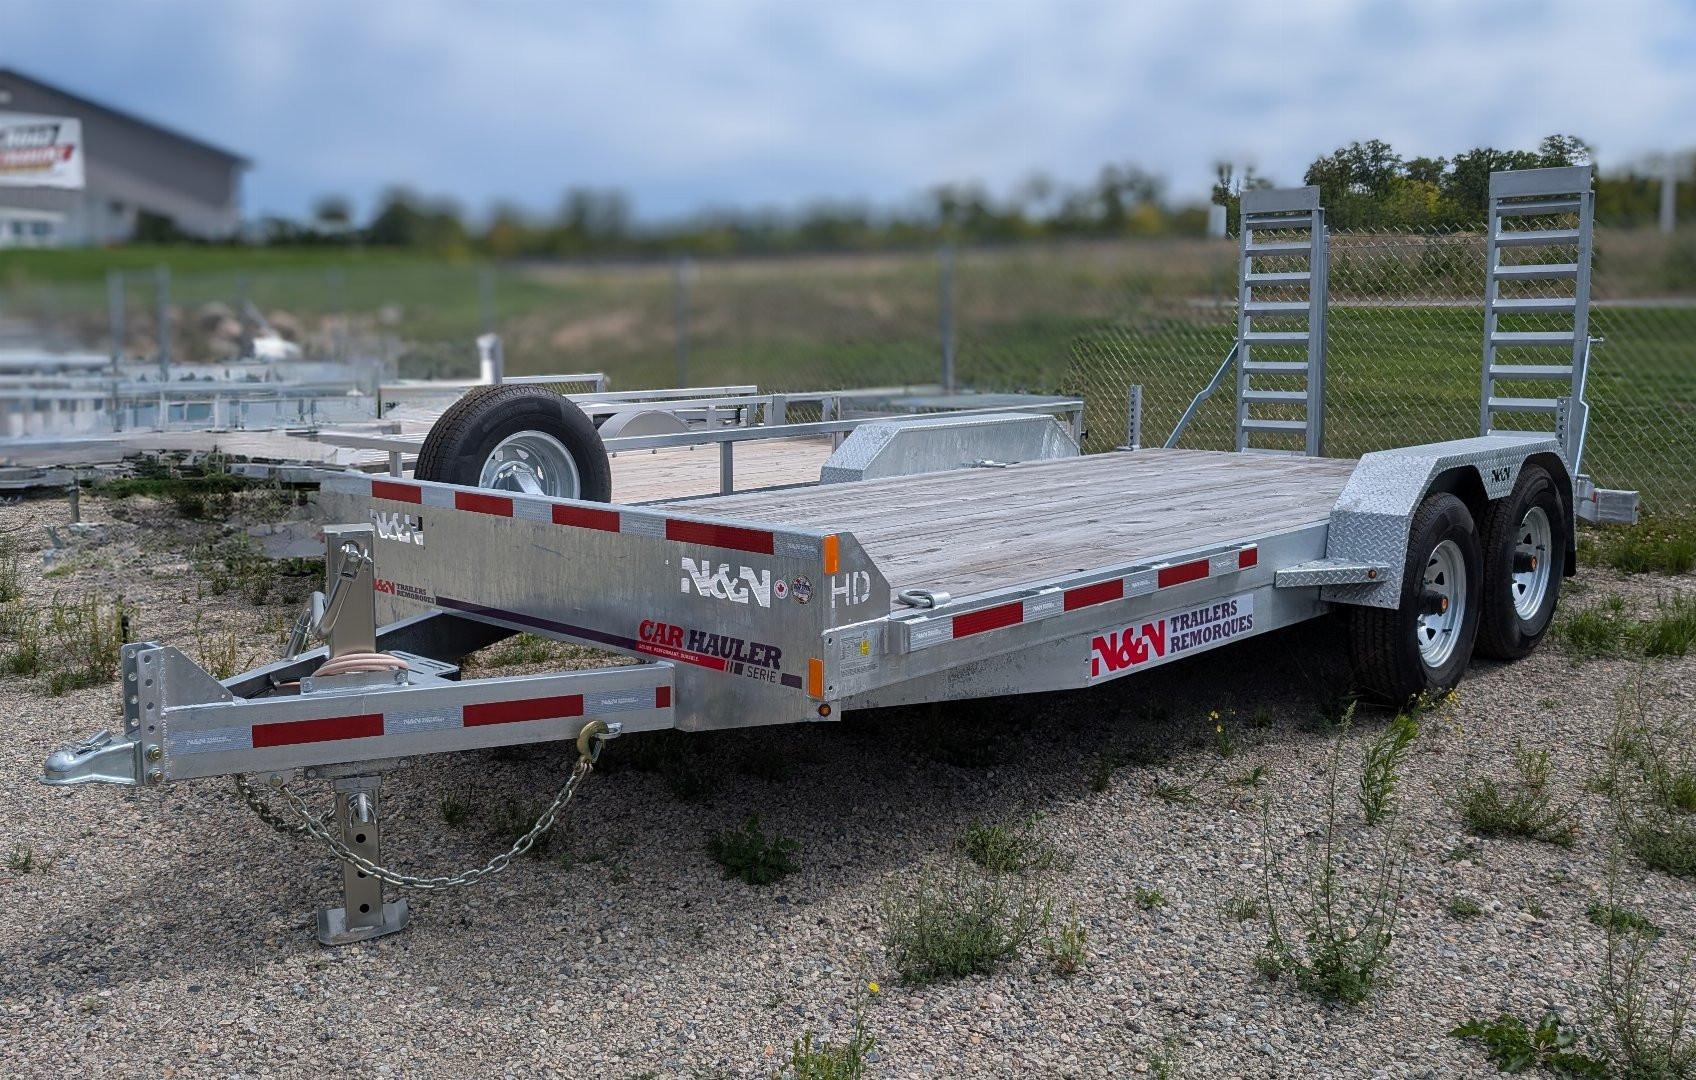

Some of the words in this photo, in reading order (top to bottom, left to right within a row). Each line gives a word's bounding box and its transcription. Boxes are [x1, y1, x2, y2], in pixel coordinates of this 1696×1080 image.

[396, 583, 427, 596] TRAILERS
[396, 590, 436, 604] REMORQUES
[680, 557, 771, 609] N&N
[831, 571, 871, 609] HD
[1170, 600, 1238, 634] TRAILERS
[1170, 613, 1254, 654] REMORQUES
[638, 619, 685, 649] CAR
[686, 629, 783, 671] HAULER
[1091, 619, 1166, 678] N&N
[746, 665, 778, 685] SERIE
